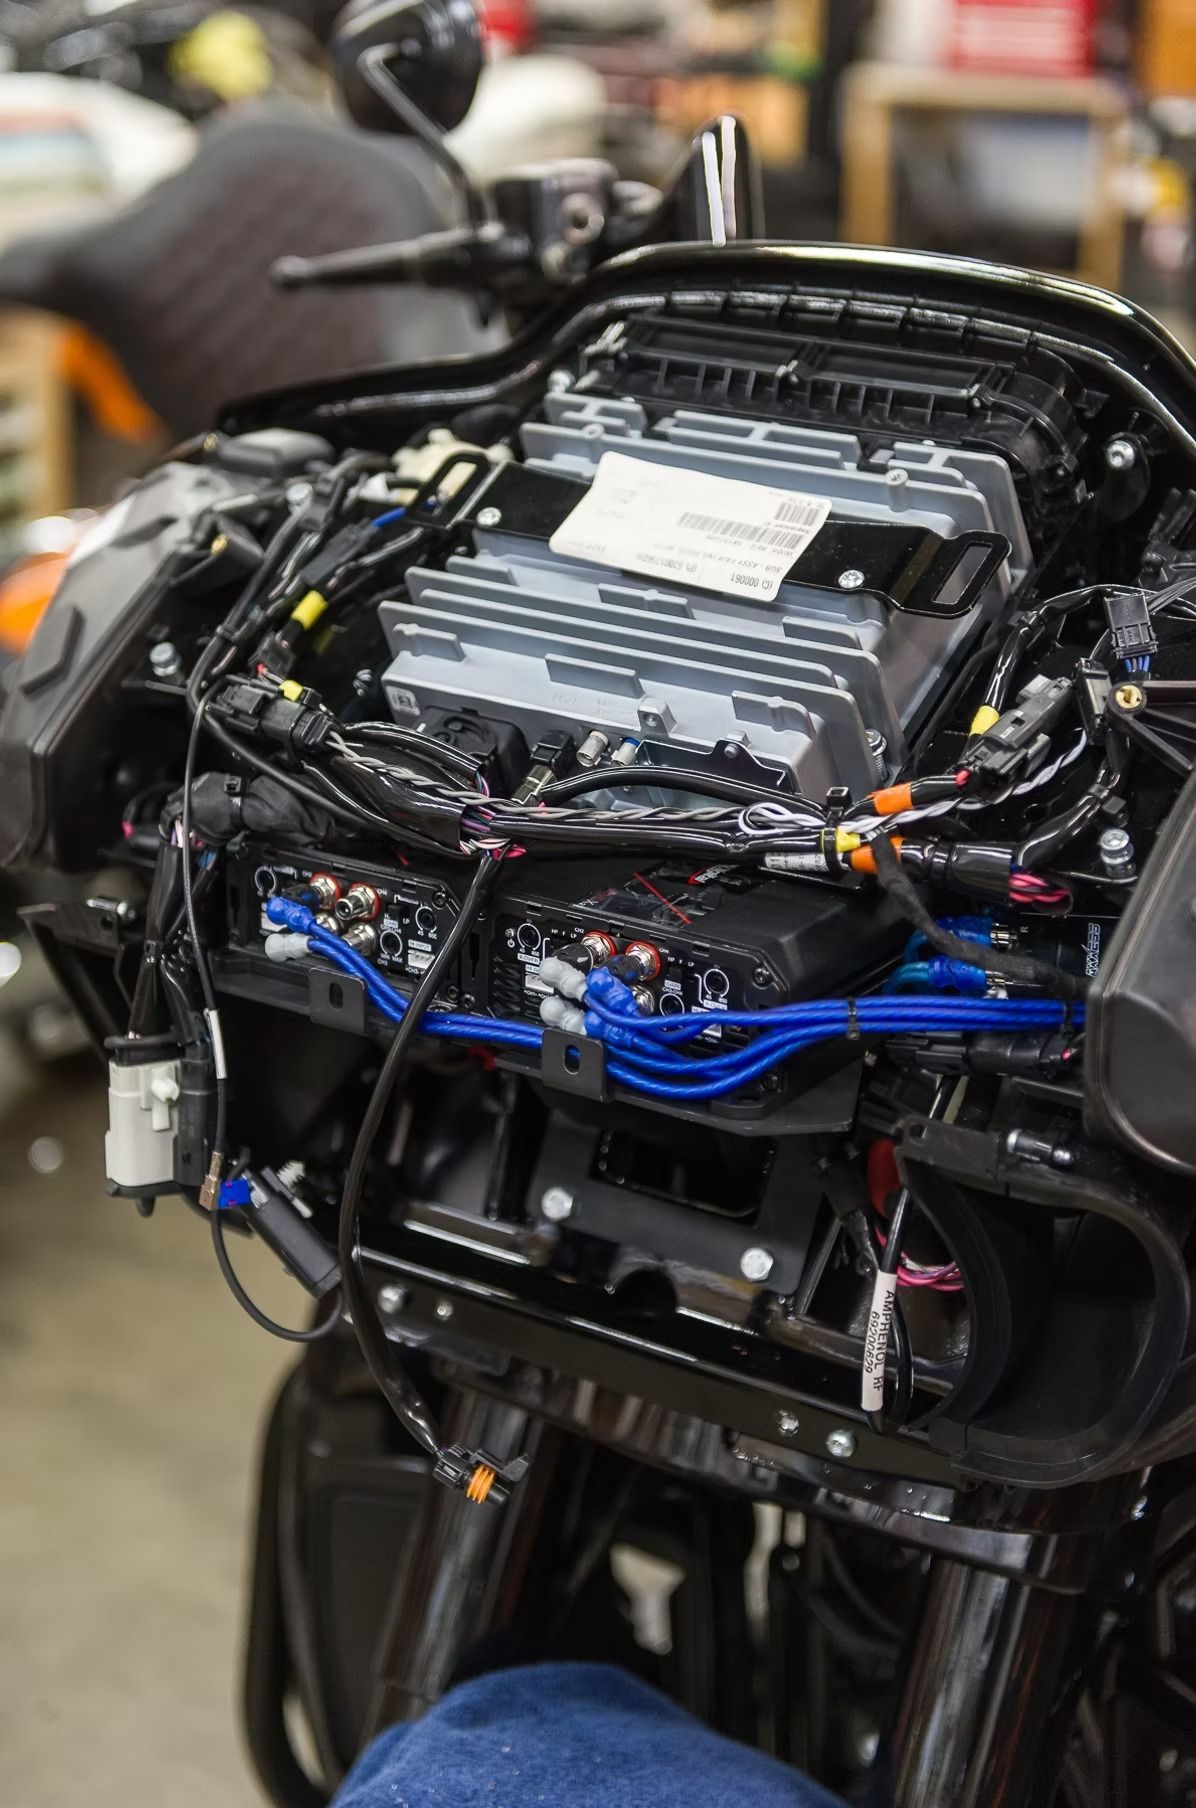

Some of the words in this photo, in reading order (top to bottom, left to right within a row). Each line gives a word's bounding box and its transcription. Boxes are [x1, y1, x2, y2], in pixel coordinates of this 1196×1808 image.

[730, 572, 760, 590] 000061
[874, 1290, 895, 1369] AMPHENOL
[873, 1376, 884, 1392] RF
